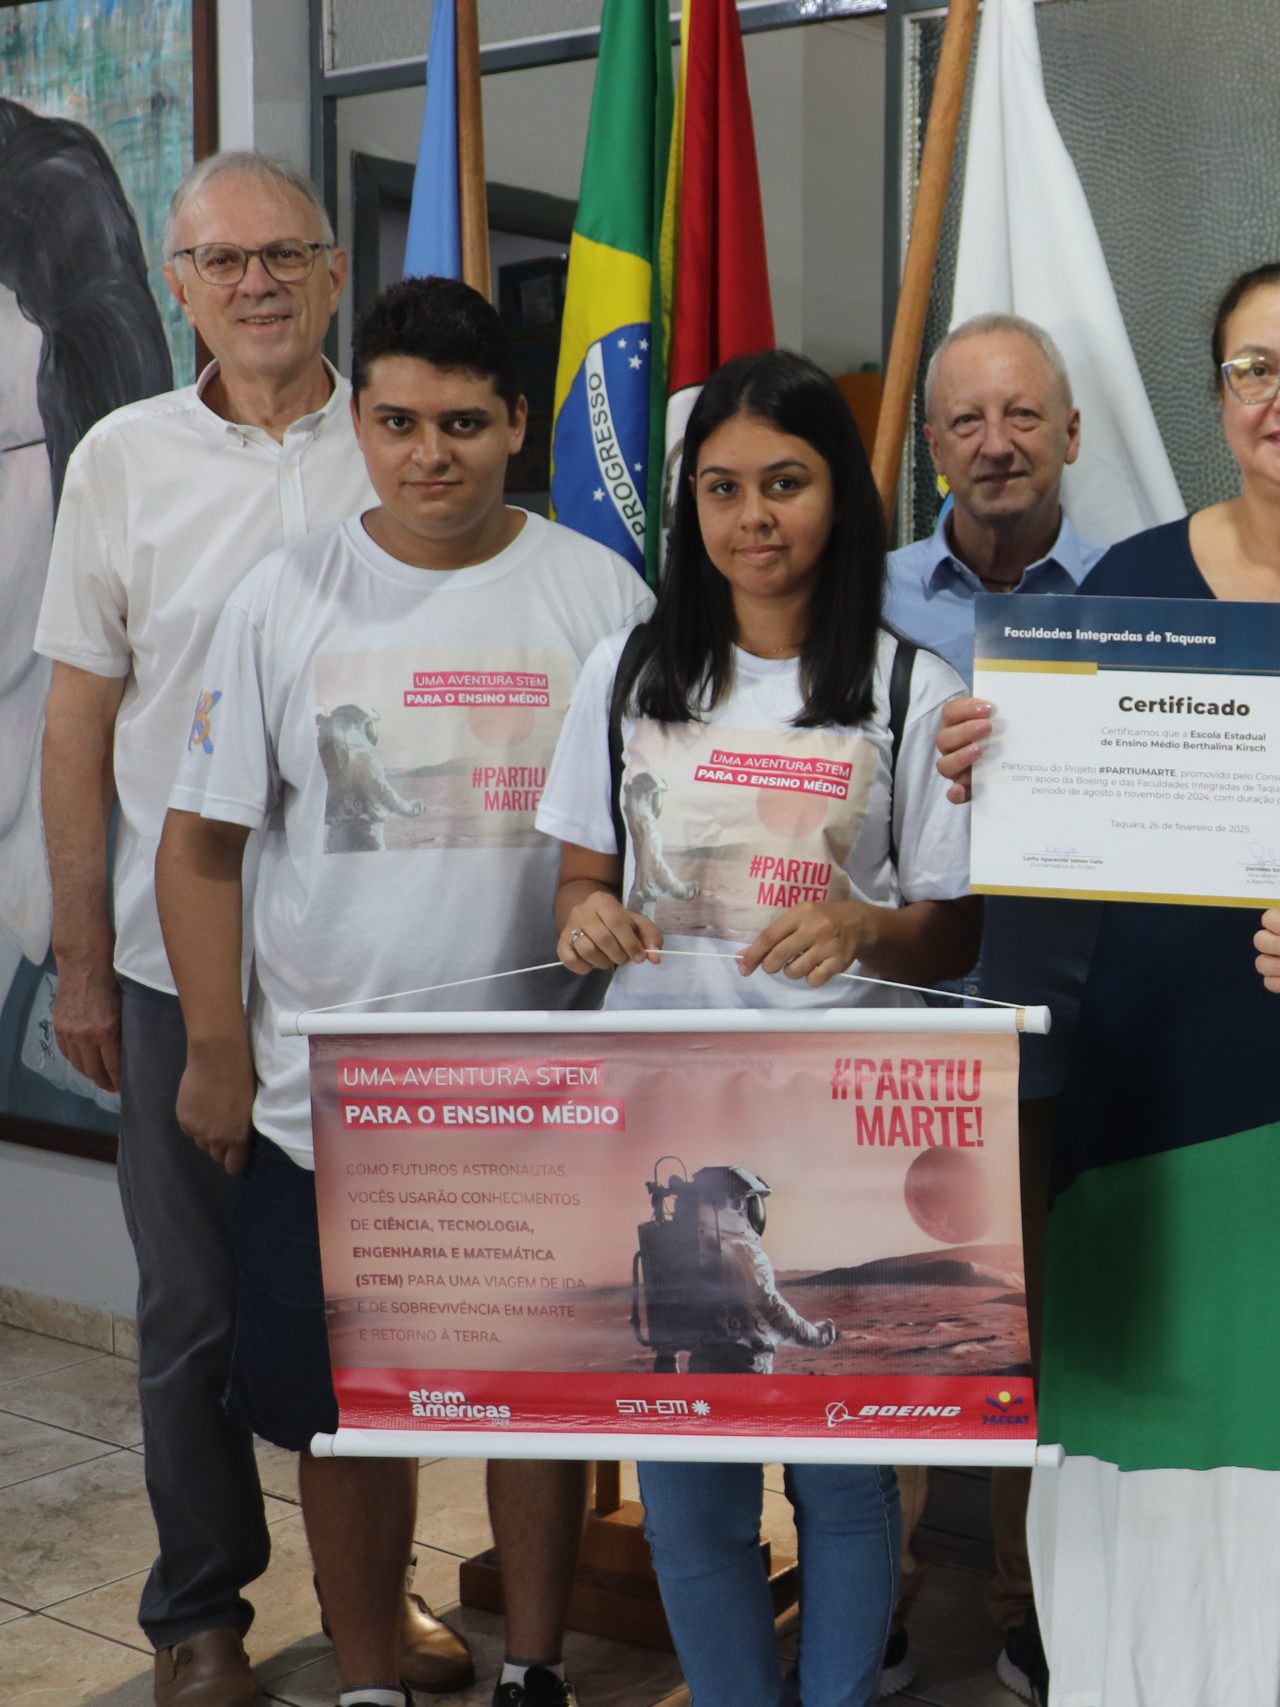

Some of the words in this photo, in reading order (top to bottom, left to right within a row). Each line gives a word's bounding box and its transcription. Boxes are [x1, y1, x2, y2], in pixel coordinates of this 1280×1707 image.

[589, 373, 647, 537] PROGRESSO
[1004, 626, 1072, 639] Faculdades
[1075, 628, 1142, 643] Integradas
[1145, 630, 1161, 642] de
[1164, 631, 1216, 645] Taquara
[416, 675, 444, 686] UMA
[447, 675, 514, 686] AVENTURA
[516, 676, 547, 687] STEM
[406, 694, 441, 704] PARA
[445, 694, 455, 704] O
[458, 693, 505, 704] ENSINO
[509, 691, 548, 704] MÉDIO
[1118, 695, 1250, 716] Certificado
[1101, 727, 1159, 737] Certificamos
[1190, 730, 1221, 739] Escola
[1223, 731, 1266, 740] Estadual
[1100, 738, 1112, 746] de
[1115, 738, 1148, 747] Ensino
[1150, 740, 1180, 748] Médio
[1182, 741, 1233, 750] Berthalina
[1235, 743, 1266, 752] Kirsch
[713, 752, 742, 766] UMA
[745, 757, 813, 772] AVENTURA
[816, 762, 850, 777] STEM
[1001, 761, 1047, 771] Participou
[1049, 764, 1061, 772] do
[1064, 764, 1096, 773] Projeto
[1098, 766, 1176, 776] #PARTIUMARTE,
[1180, 770, 1230, 778] promovido
[472, 767, 546, 788] #PARTIU
[698, 769, 733, 781] PARA
[737, 772, 748, 783] O
[750, 775, 801, 788] ENSINO
[803, 778, 847, 796] MÉDIO
[1034, 776, 1060, 785] apoio
[1061, 775, 1073, 784] da
[1075, 776, 1108, 787] Boeing
[1118, 777, 1135, 786] das
[1137, 778, 1189, 788] Faculdades
[1191, 780, 1240, 791] Integradas
[1242, 783, 1254, 791] de
[1031, 786, 1067, 795] período
[1068, 787, 1080, 795] de
[1082, 786, 1113, 797] agosto
[1123, 790, 1171, 799] novembro
[1172, 791, 1185, 800] de
[1186, 790, 1212, 801] 2024,
[1236, 794, 1275, 804] duração
[1110, 819, 1146, 829] Taquara,
[1148, 820, 1159, 829] 26
[1161, 822, 1173, 830] de
[1174, 822, 1213, 832] fevereiro
[1214, 823, 1226, 832] de
[1228, 824, 1250, 833] 2025.
[749, 855, 832, 886] #PARTIU
[342, 1067, 398, 1085] UMA
[403, 1067, 529, 1085] AVENTURA
[536, 1066, 597, 1085] STEM
[830, 1058, 982, 1102] #PARTIU
[345, 1105, 411, 1123] PARA
[417, 1106, 435, 1124] O
[442, 1105, 534, 1123] ENSINO
[542, 1100, 618, 1124] MÉDIO
[855, 1105, 984, 1147] MARTE!
[346, 1162, 389, 1175] COMO
[392, 1163, 457, 1175] FUTUROS
[462, 1163, 569, 1178] ASTRONAUTAS,
[347, 1188, 395, 1203] VOCÊS
[398, 1189, 457, 1204] USARÃO
[460, 1191, 580, 1205] CONHECIMENTOS
[350, 1218, 368, 1230] DE
[373, 1216, 433, 1232] CIÊNCIA,
[437, 1218, 534, 1233] TECNOLOGIA,
[352, 1246, 447, 1258] ENGENHARIA
[451, 1247, 459, 1258] E
[463, 1245, 555, 1260] MATEMÁTICA
[355, 1273, 403, 1288] (STEM)
[407, 1273, 445, 1286] PARA
[448, 1274, 480, 1286] UMA
[483, 1275, 535, 1288] VIAGEM
[541, 1277, 558, 1288] DE
[562, 1277, 586, 1289] IDA
[358, 1302, 365, 1312] E
[369, 1301, 386, 1312] DE
[391, 1301, 500, 1315] SOBREVIVÊNCIA
[503, 1303, 523, 1316] EM
[527, 1305, 575, 1317] MARTE
[359, 1329, 367, 1339] E
[371, 1328, 436, 1341] RETORNO
[440, 1327, 450, 1341] À
[453, 1329, 501, 1343] TERRA.
[408, 1389, 466, 1404] stem
[858, 1405, 961, 1417] BOEING
[982, 1414, 1030, 1424] FACCAT
